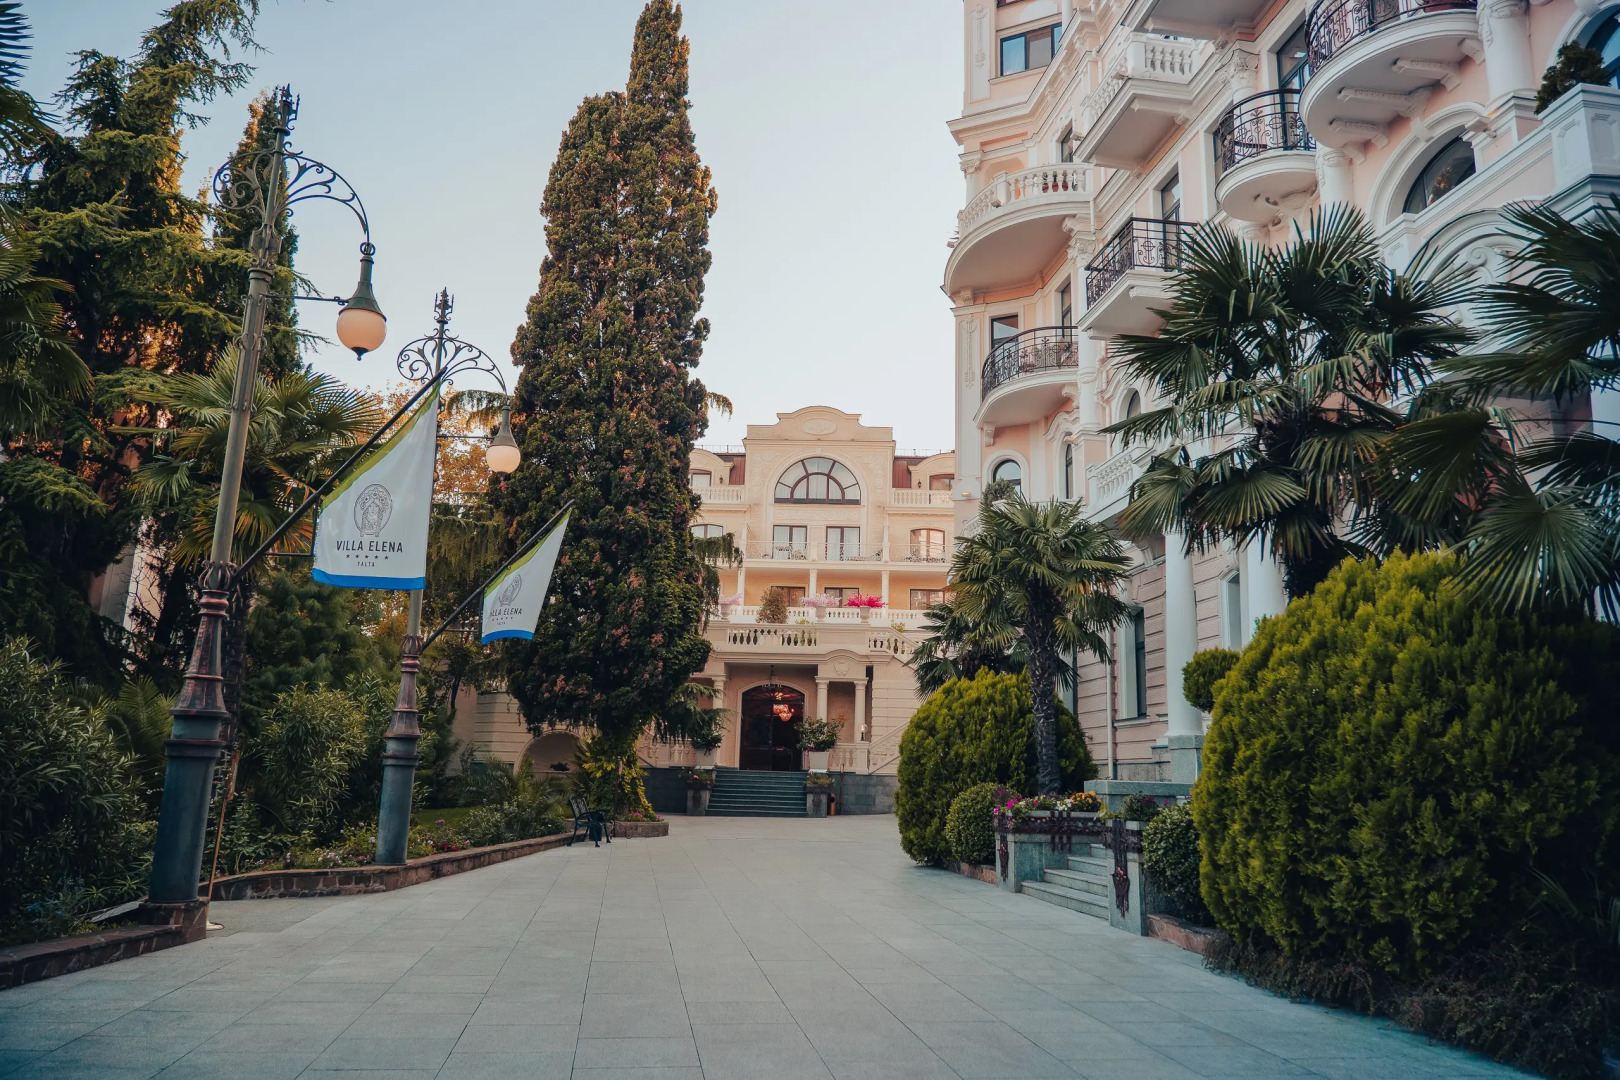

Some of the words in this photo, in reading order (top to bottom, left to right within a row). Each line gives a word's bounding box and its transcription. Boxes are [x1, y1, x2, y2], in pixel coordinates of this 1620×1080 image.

[336, 540, 363, 551] VILLA
[368, 540, 403, 553] ELENA
[503, 607, 522, 616] ELENA
